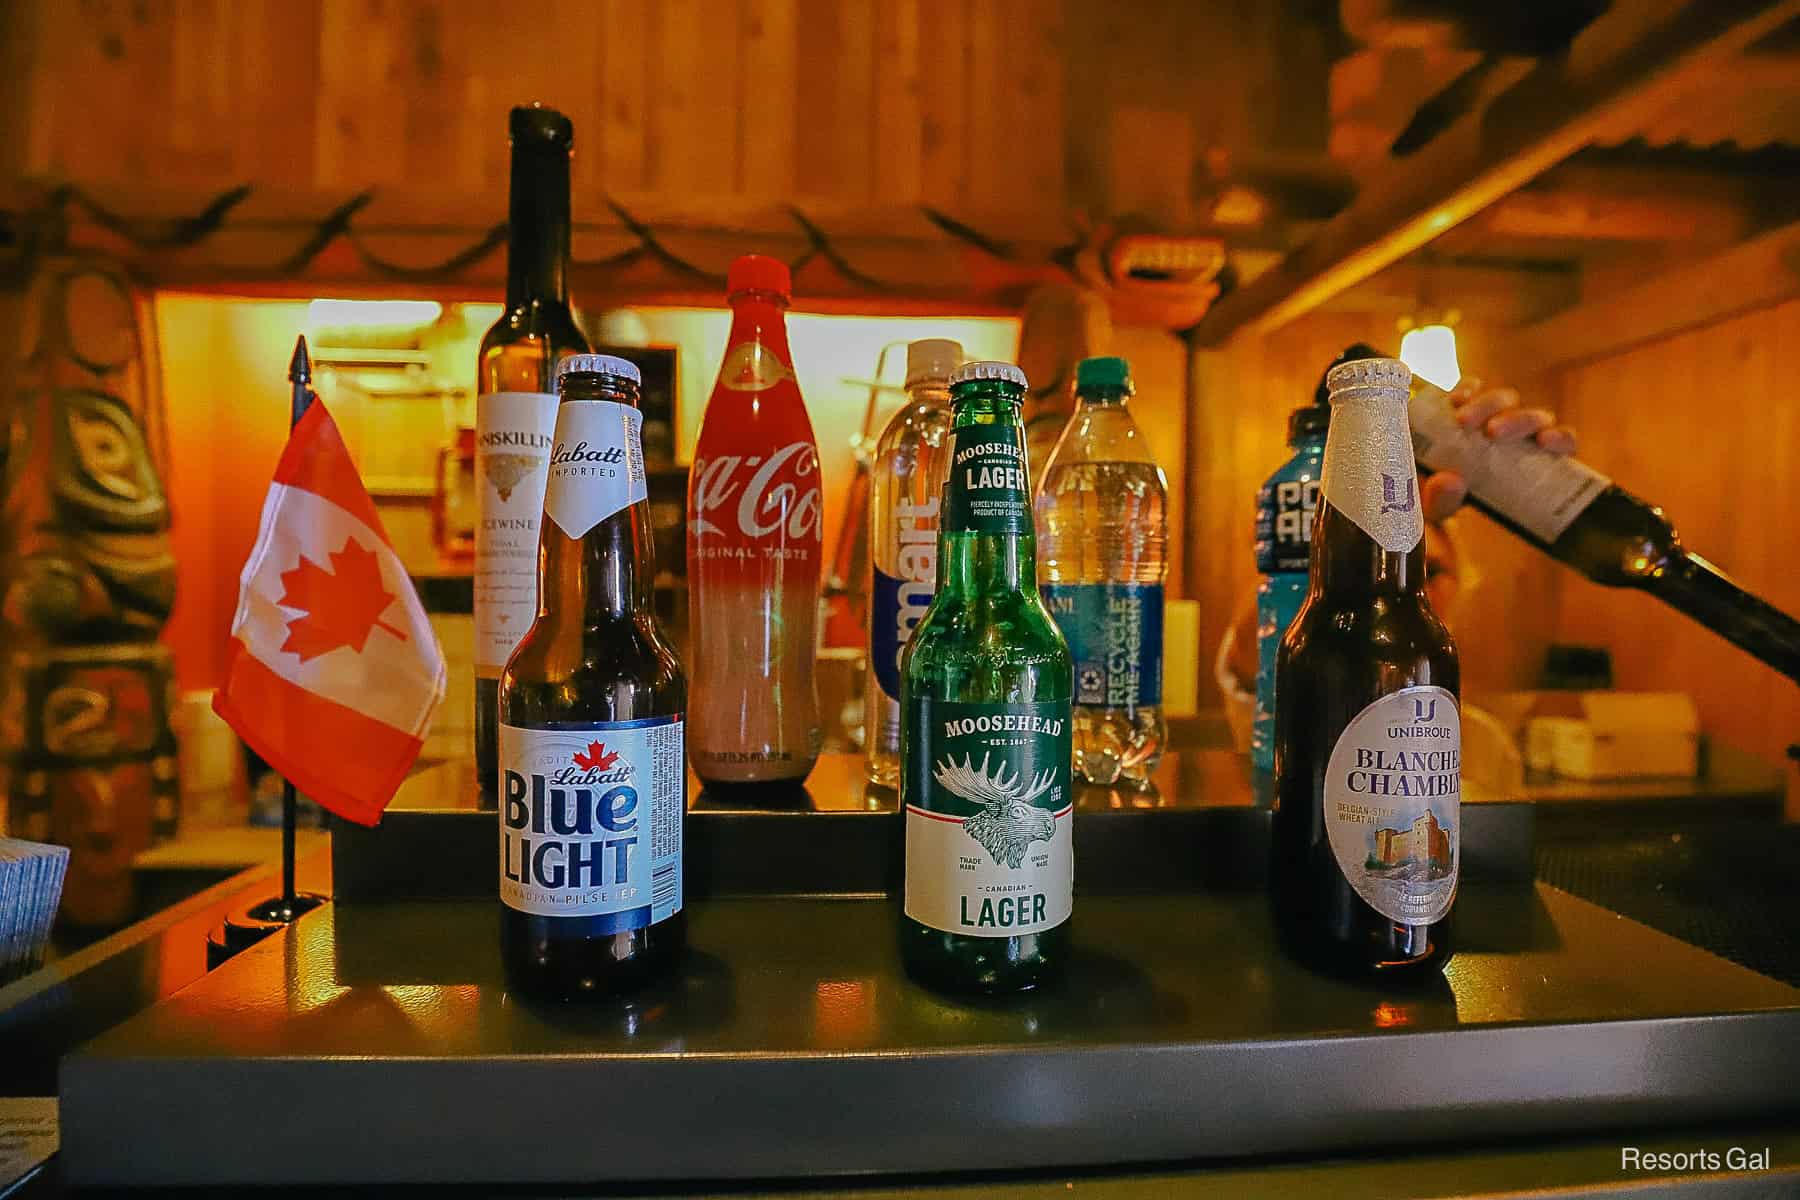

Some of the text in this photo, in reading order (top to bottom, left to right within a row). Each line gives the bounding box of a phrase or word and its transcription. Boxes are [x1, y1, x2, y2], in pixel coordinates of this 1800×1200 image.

[957, 443, 1025, 464] MOOSEHEA
[551, 467, 616, 479] IMPORTED
[967, 466, 1025, 491] LAGER
[974, 508, 997, 517] PRODUCT
[998, 508, 1004, 516] OF
[764, 546, 808, 561] TASTE
[896, 496, 941, 672] mart
[1107, 599, 1126, 704] RECYCLE
[1125, 599, 1141, 704] ME AGAIN
[945, 715, 1062, 738] MOOSEHEAD
[1387, 726, 1451, 739] UNIBROUE
[990, 738, 1007, 746] EST.
[550, 765, 633, 786] Labatt
[504, 768, 639, 836] Blue
[1338, 812, 1366, 824] WHEAT
[504, 832, 638, 890] LIGHT
[960, 856, 982, 865] TRADE
[960, 863, 977, 871] MARK
[960, 893, 1047, 928] LAGER
